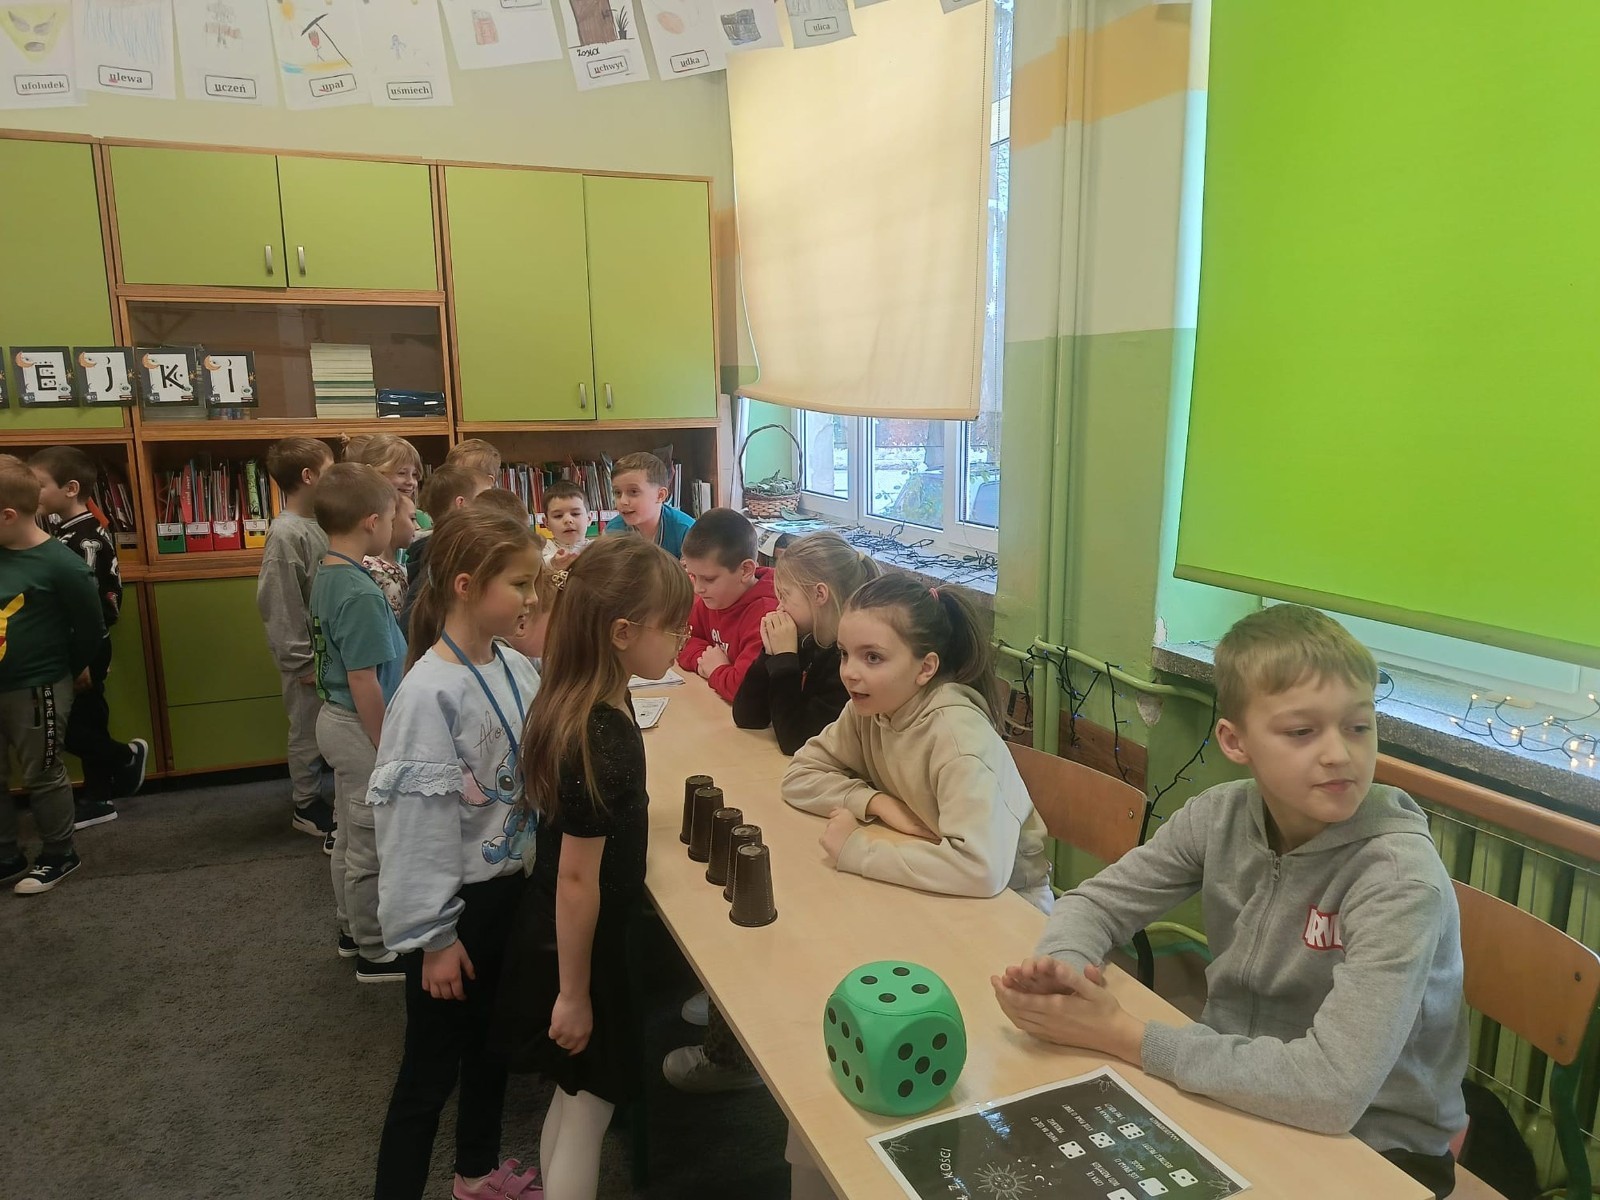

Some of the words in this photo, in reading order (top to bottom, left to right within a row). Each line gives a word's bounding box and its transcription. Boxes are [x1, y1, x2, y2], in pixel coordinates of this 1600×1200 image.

[813, 23, 831, 32] ulica
[594, 61, 625, 74] uchwyt
[109, 72, 143, 84] ulewa
[21, 80, 65, 91] ufoludek
[214, 81, 246, 94] uczeń
[390, 86, 430, 96] uśmiech
[938, 1147, 955, 1179] KOŚCI
